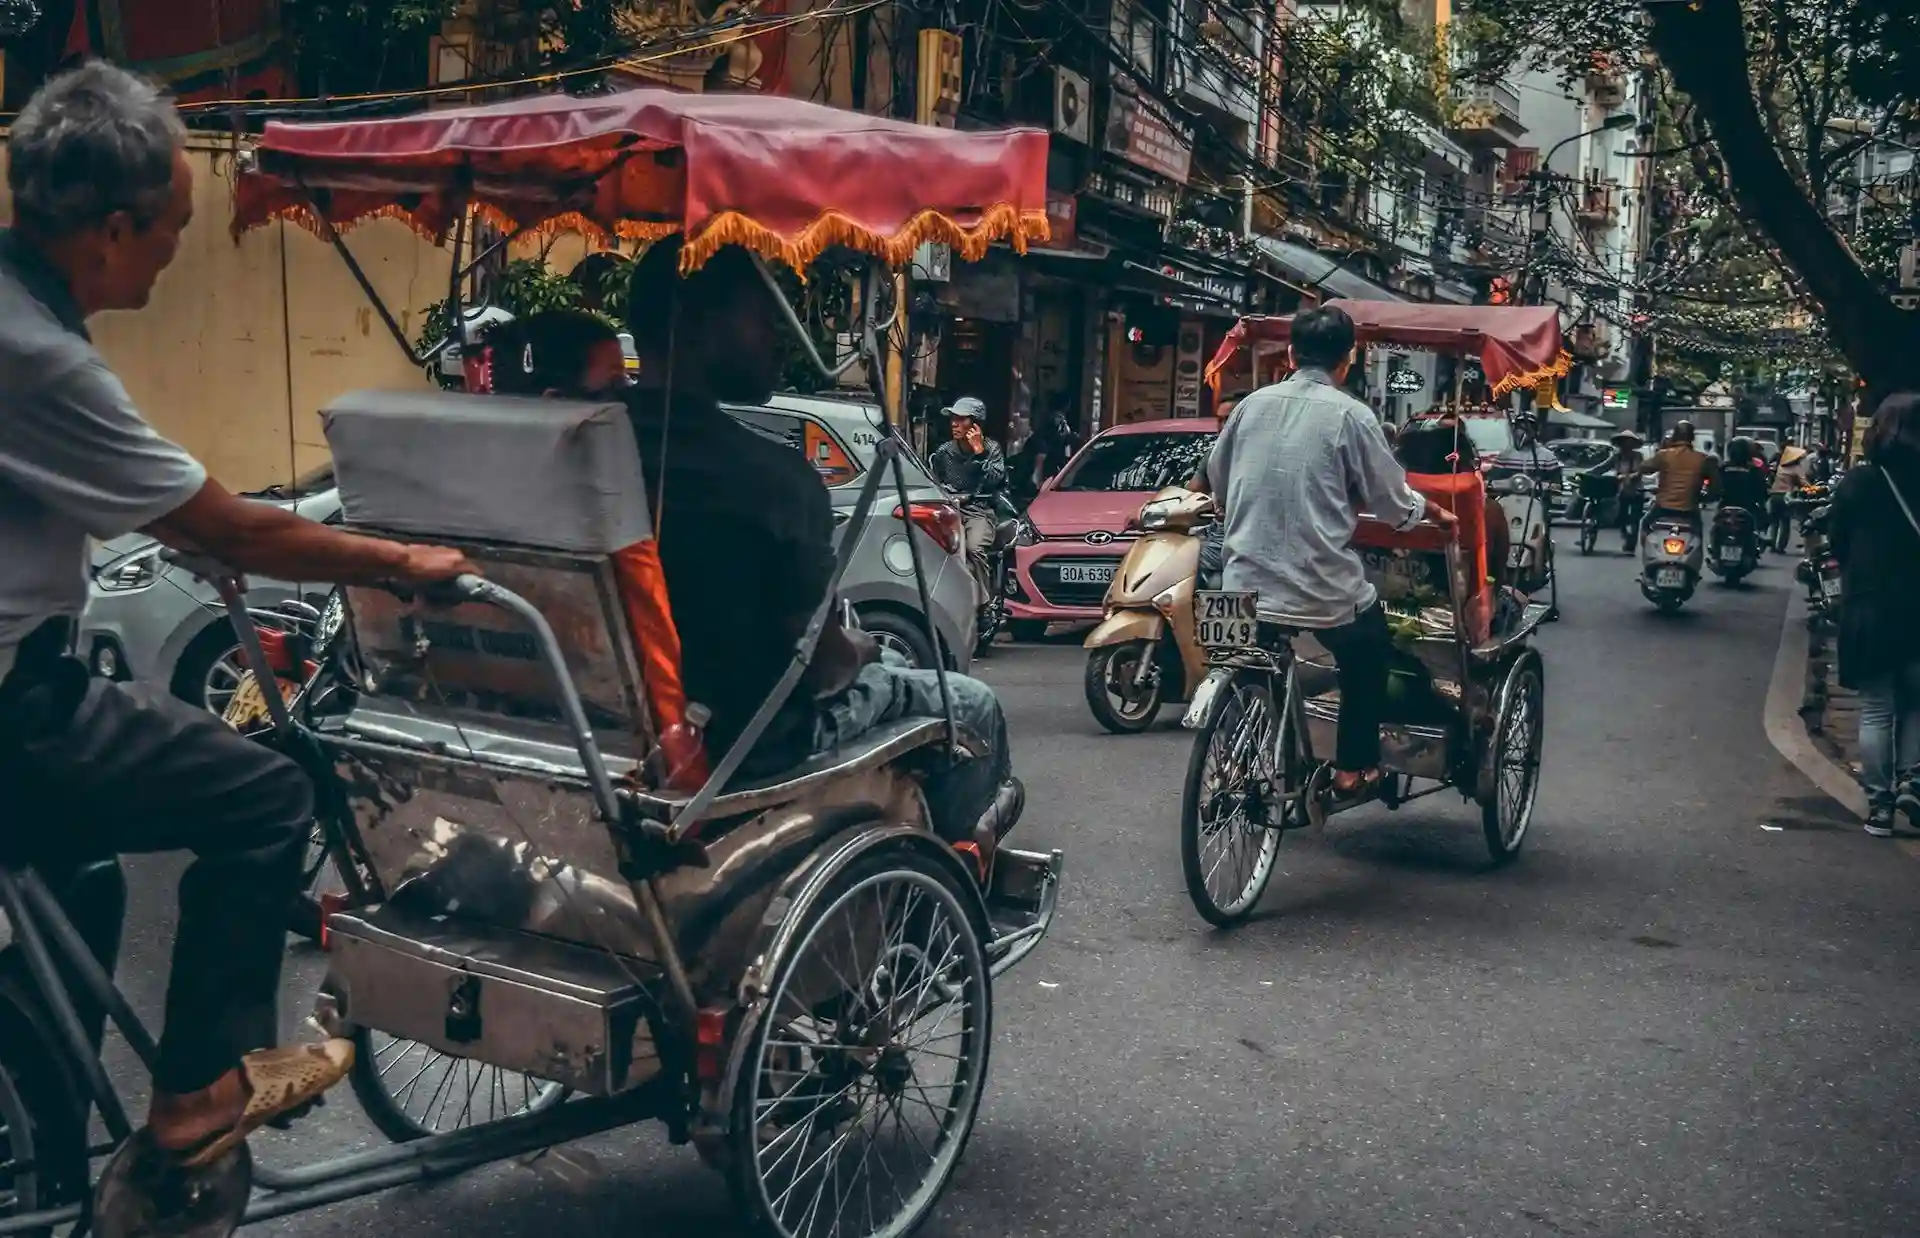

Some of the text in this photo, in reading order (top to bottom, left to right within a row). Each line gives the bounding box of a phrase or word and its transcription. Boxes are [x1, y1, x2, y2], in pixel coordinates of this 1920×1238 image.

[853, 432, 876, 446] 414
[1062, 567, 1119, 581] 30A-639
[1200, 621, 1250, 644] 0049
